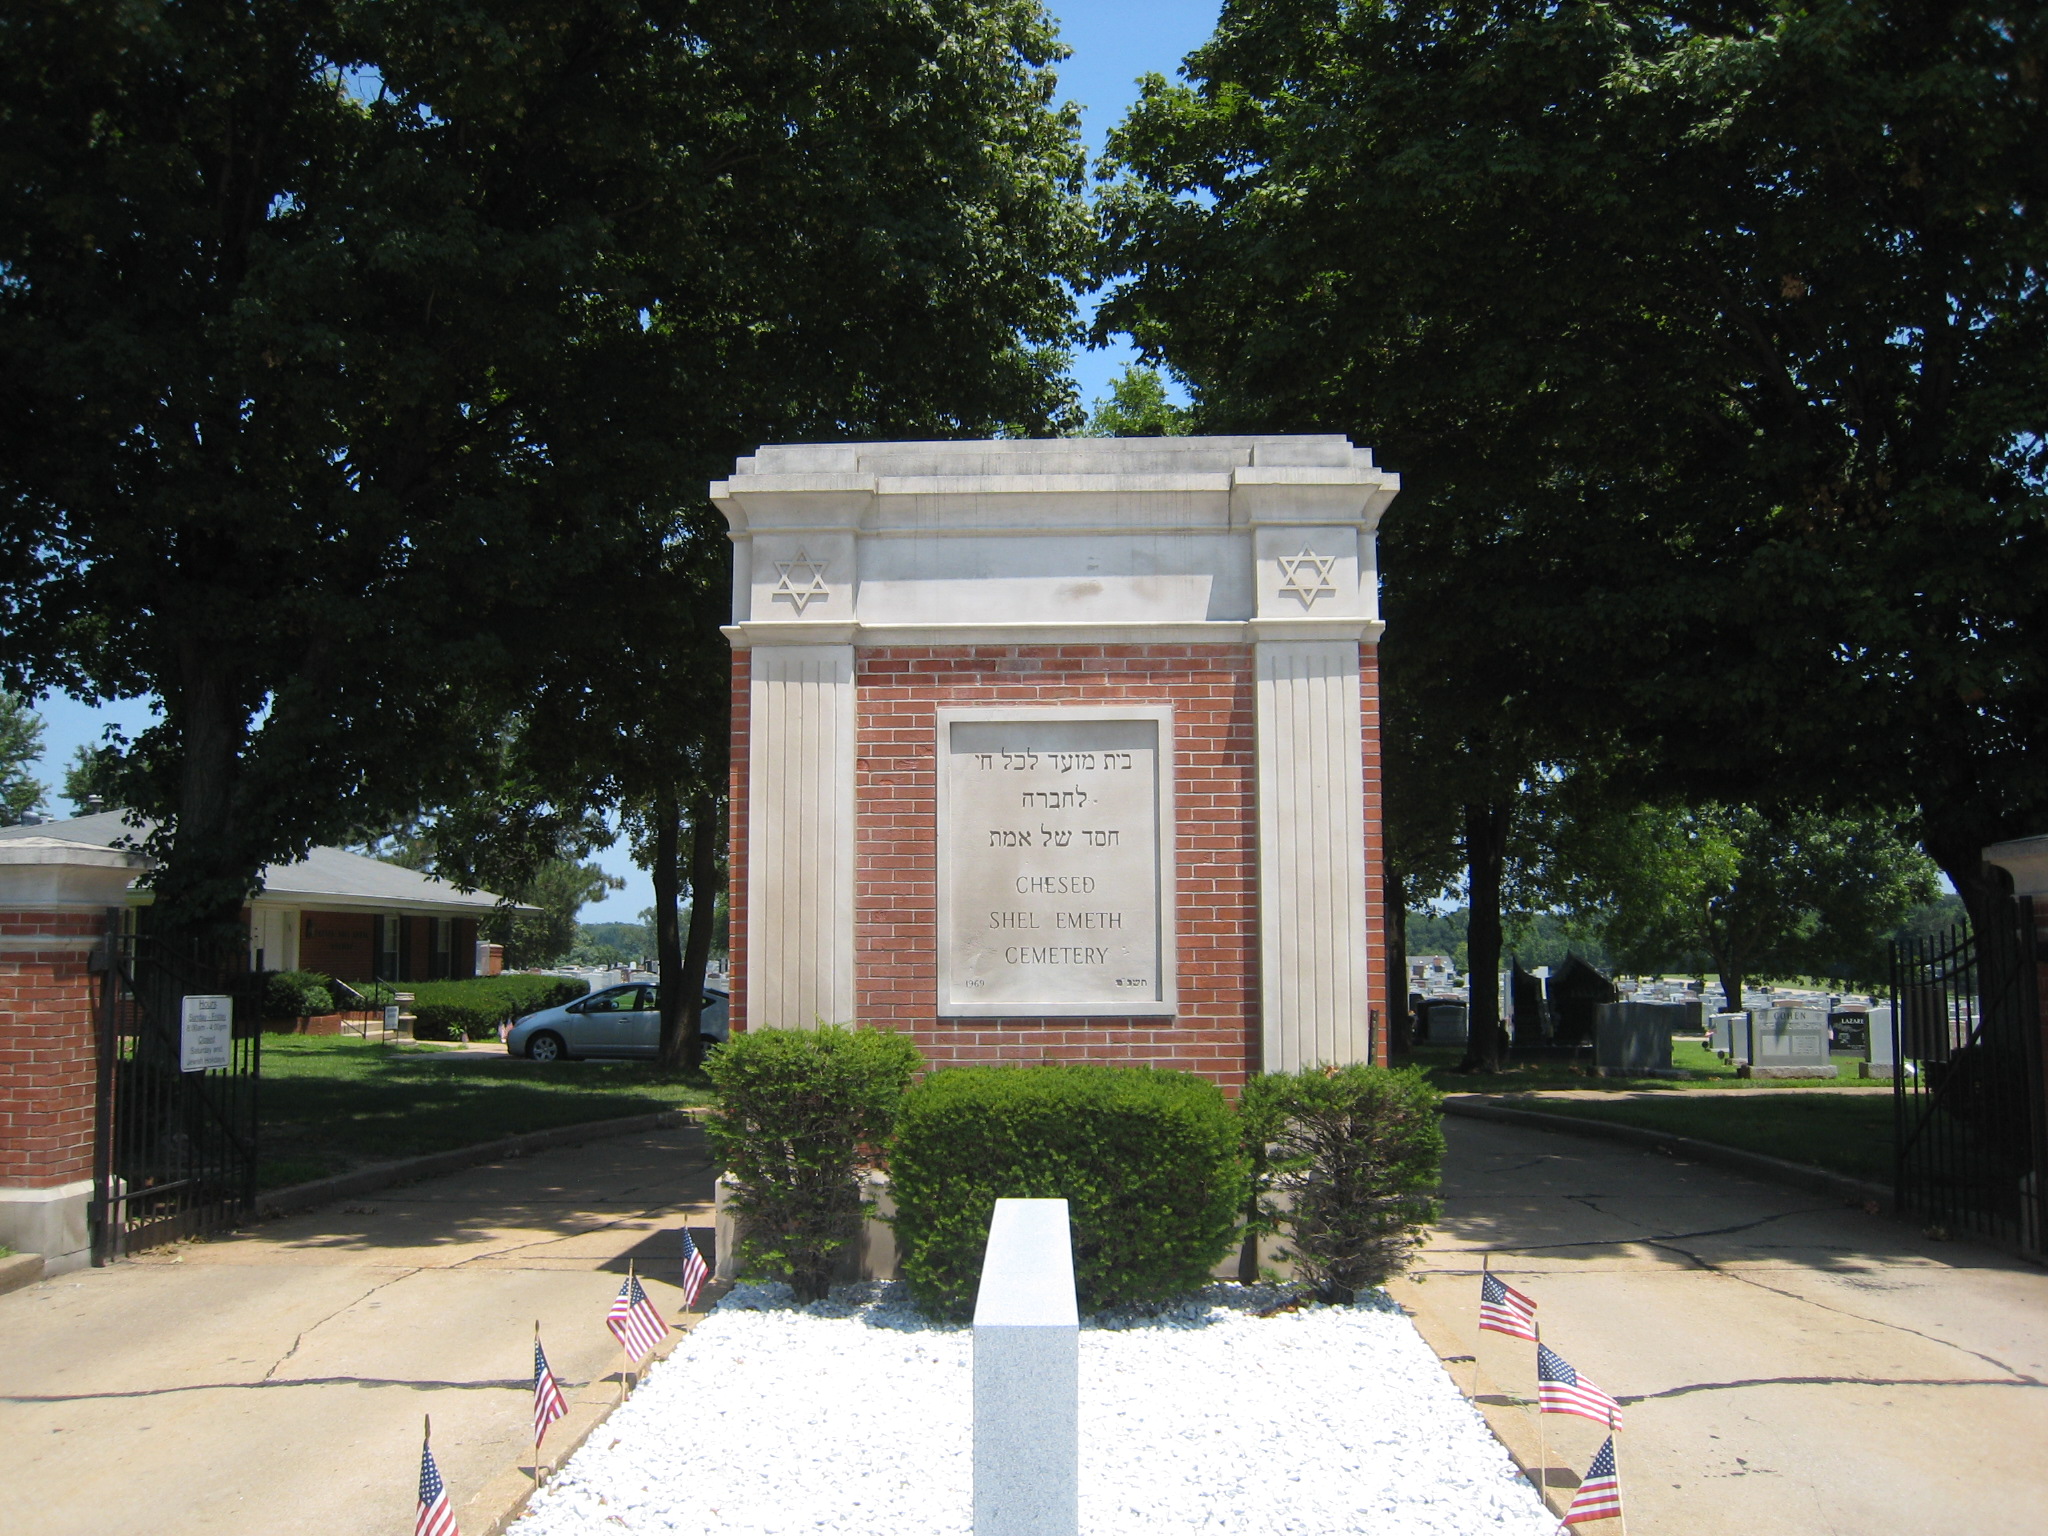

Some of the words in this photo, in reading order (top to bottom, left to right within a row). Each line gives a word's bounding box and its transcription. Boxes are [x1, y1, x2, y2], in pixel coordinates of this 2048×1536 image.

[975, 754, 993, 770] חי
[1001, 747, 1039, 771] לכל
[1048, 753, 1095, 773] מועד
[1103, 753, 1132, 770] בית
[1022, 784, 1087, 808] לחברה
[989, 830, 1032, 847] אמת
[1041, 823, 1072, 847] של
[1082, 830, 1120, 846] חסד
[1016, 876, 1095, 894] CHESED
[989, 911, 1040, 929] SHEL
[1056, 912, 1122, 929] EMETH
[1005, 947, 1109, 964] CEMETERY
[965, 979, 985, 988] 1969
[199, 999, 217, 1009] Hours
[1774, 1012, 1806, 1020] COHEN
